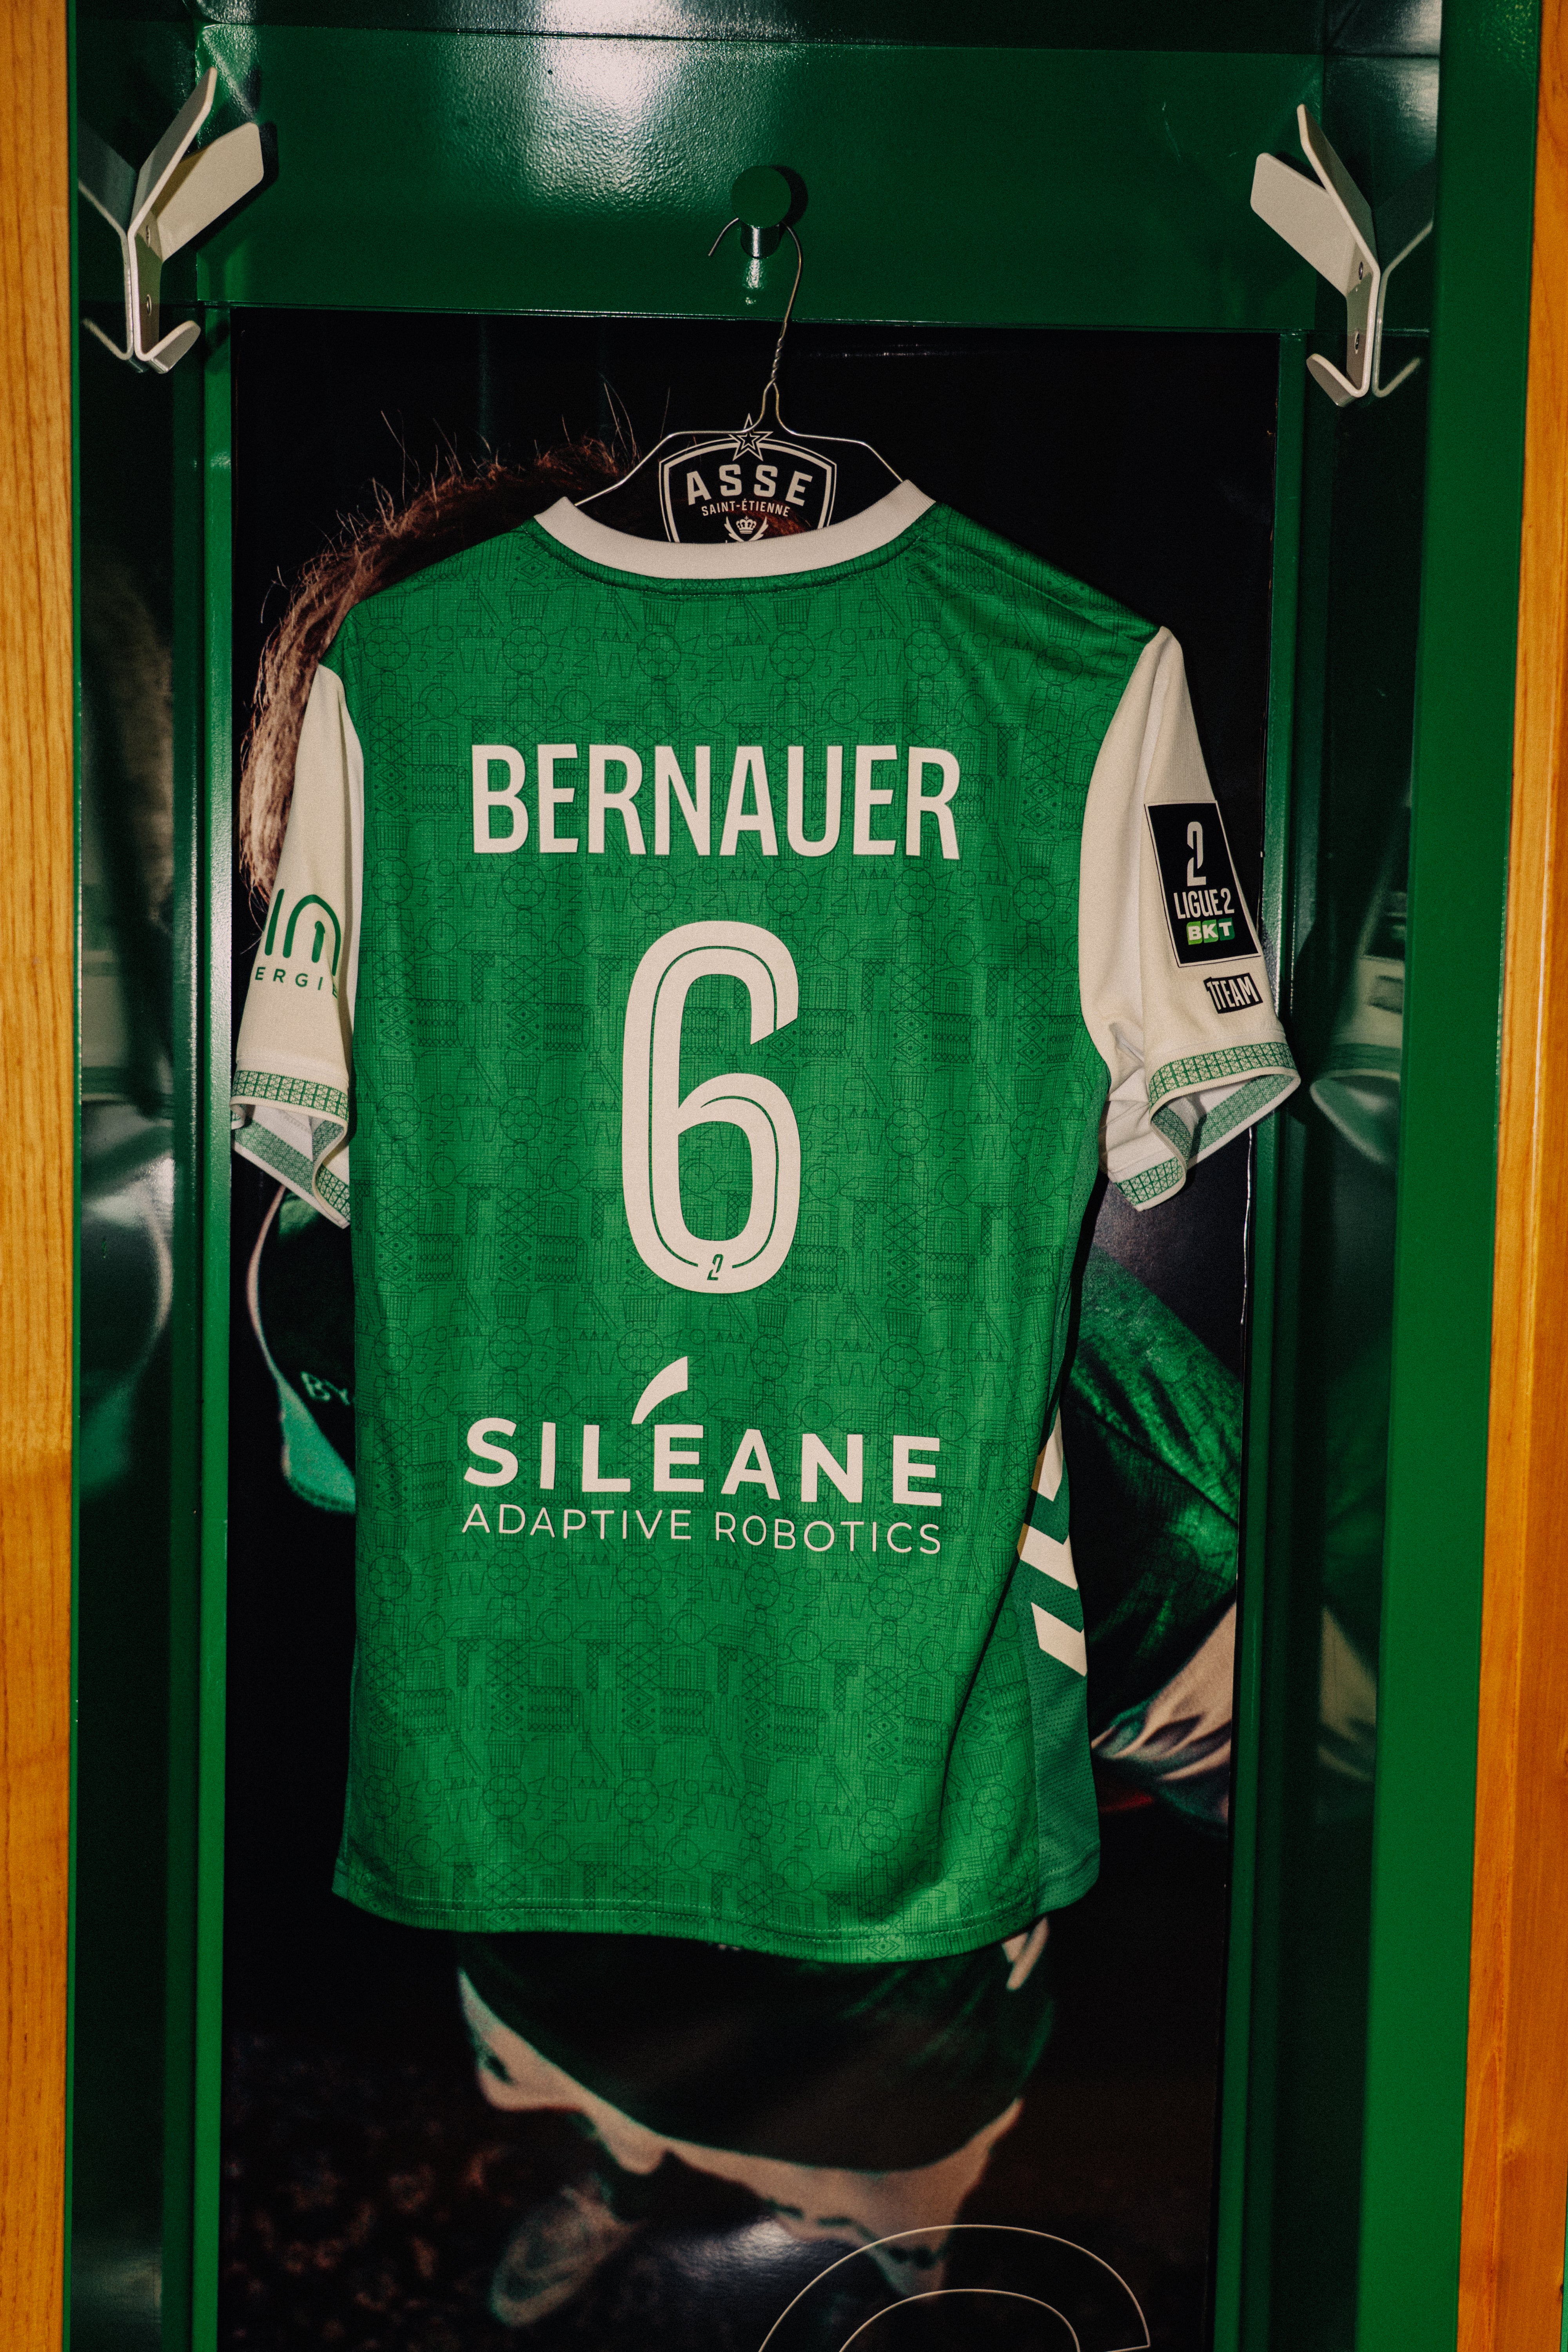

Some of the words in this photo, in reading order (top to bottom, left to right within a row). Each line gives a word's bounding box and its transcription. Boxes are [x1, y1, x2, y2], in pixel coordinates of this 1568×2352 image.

[687, 464, 813, 506] ASSE
[701, 499, 790, 517] SAINT-ÉTIENNE
[472, 744, 960, 860] BERNAUER
[1187, 822, 1206, 886] 2
[1187, 922, 1232, 941] BKT
[1206, 976, 1259, 1010] 1TEAM
[622, 920, 801, 1294] 6
[464, 1356, 942, 1506] SILÉANE
[462, 1504, 691, 1540] ADAPTIVE
[716, 1512, 941, 1554] ROBOTICS
